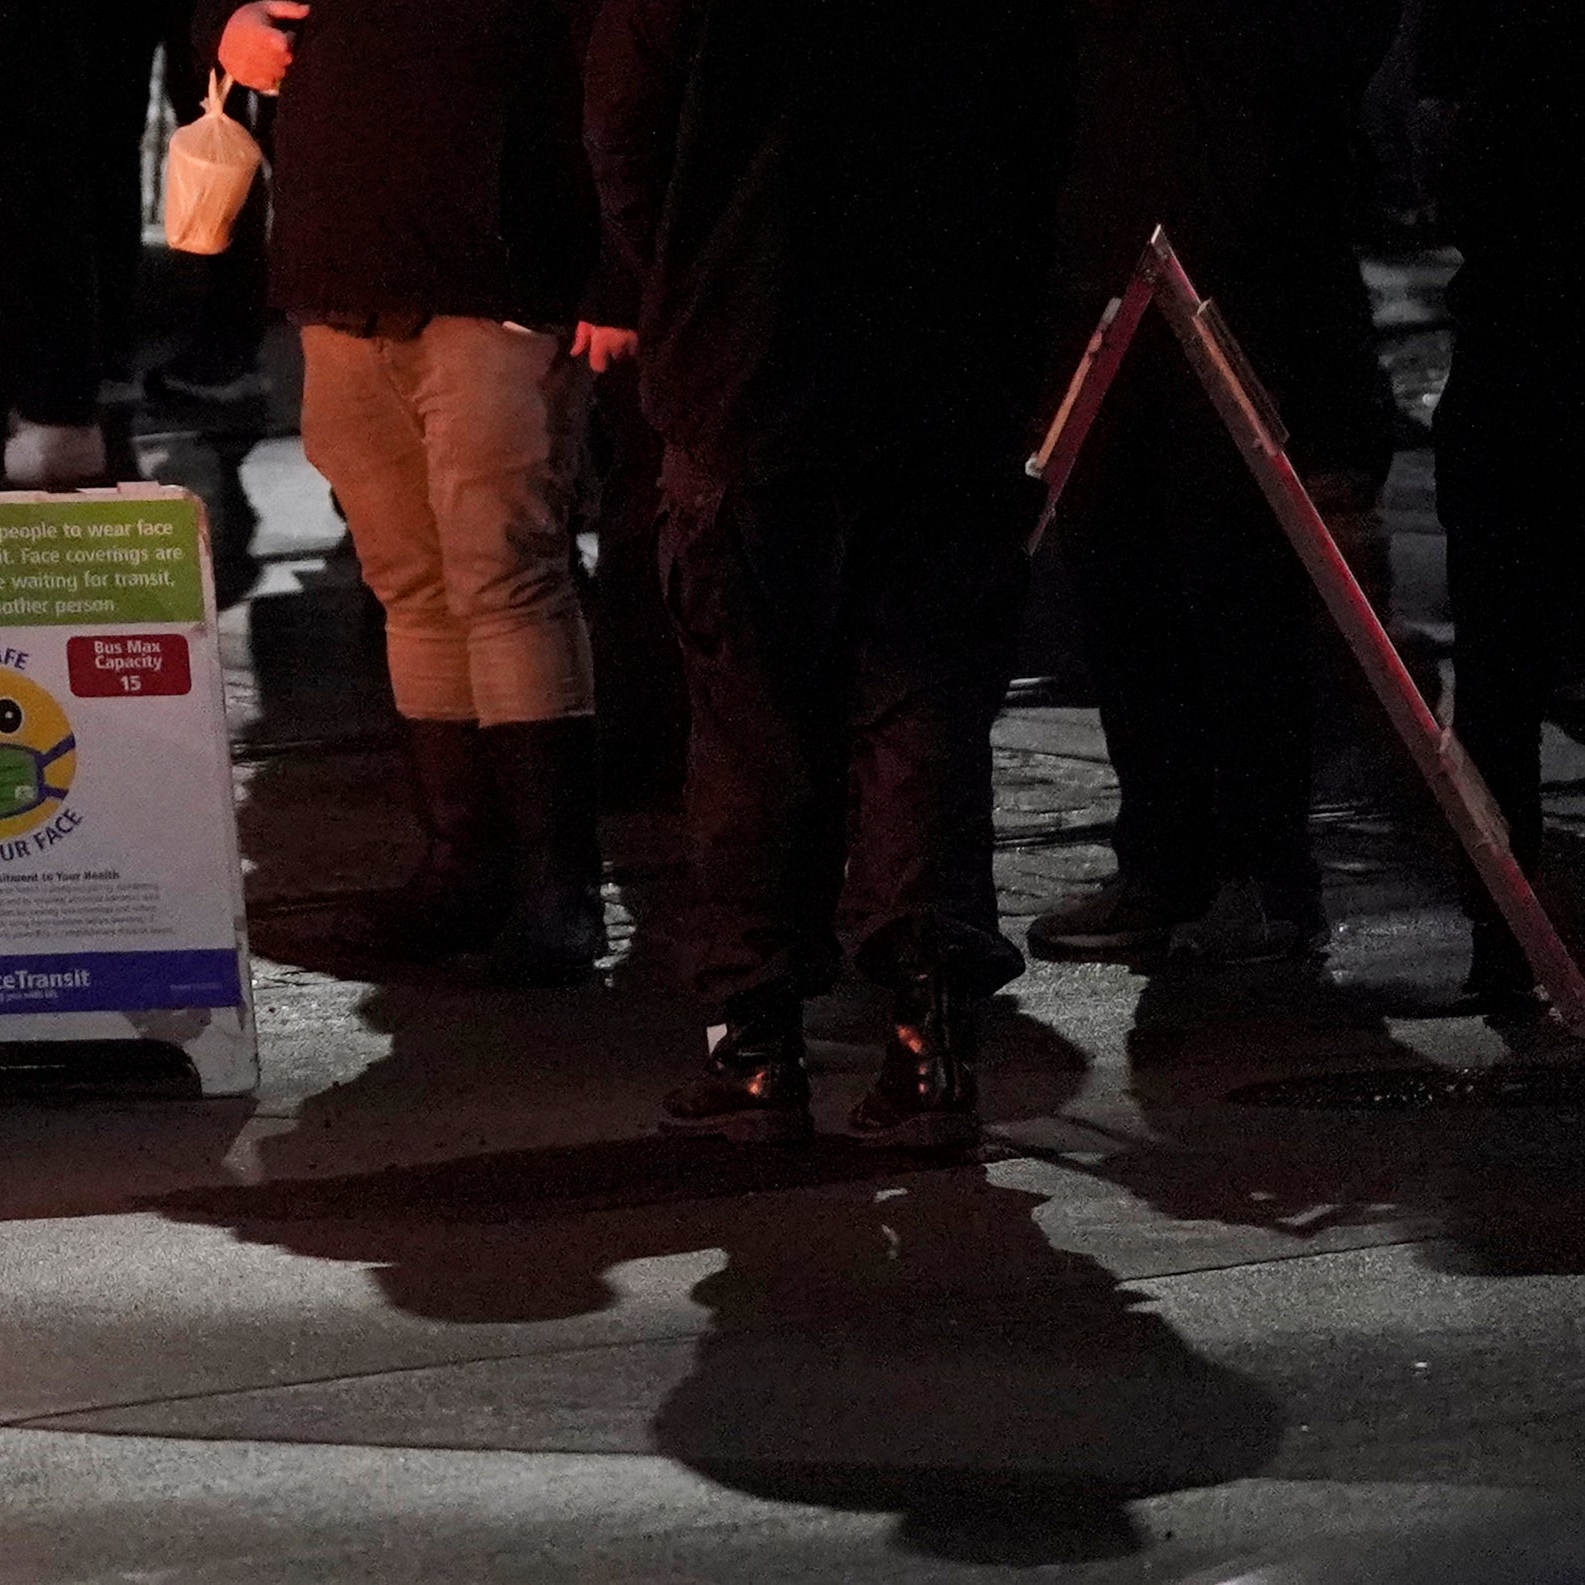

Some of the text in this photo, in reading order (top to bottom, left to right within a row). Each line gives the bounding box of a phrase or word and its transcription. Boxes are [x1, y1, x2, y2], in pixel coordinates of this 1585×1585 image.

[62, 523, 82, 538] to
[87, 525, 132, 538] wear
[136, 520, 174, 536] face
[20, 548, 60, 564] Face
[66, 546, 149, 566] coverings
[155, 546, 183, 561] are
[12, 571, 78, 592] waiting
[84, 570, 109, 587] for
[94, 639, 162, 654] Bus Max
[94, 653, 163, 673] Capacity
[120, 675, 142, 691] 15
[32, 807, 84, 850] FACE
[56, 871, 81, 882] Your
[84, 869, 120, 881] Health
